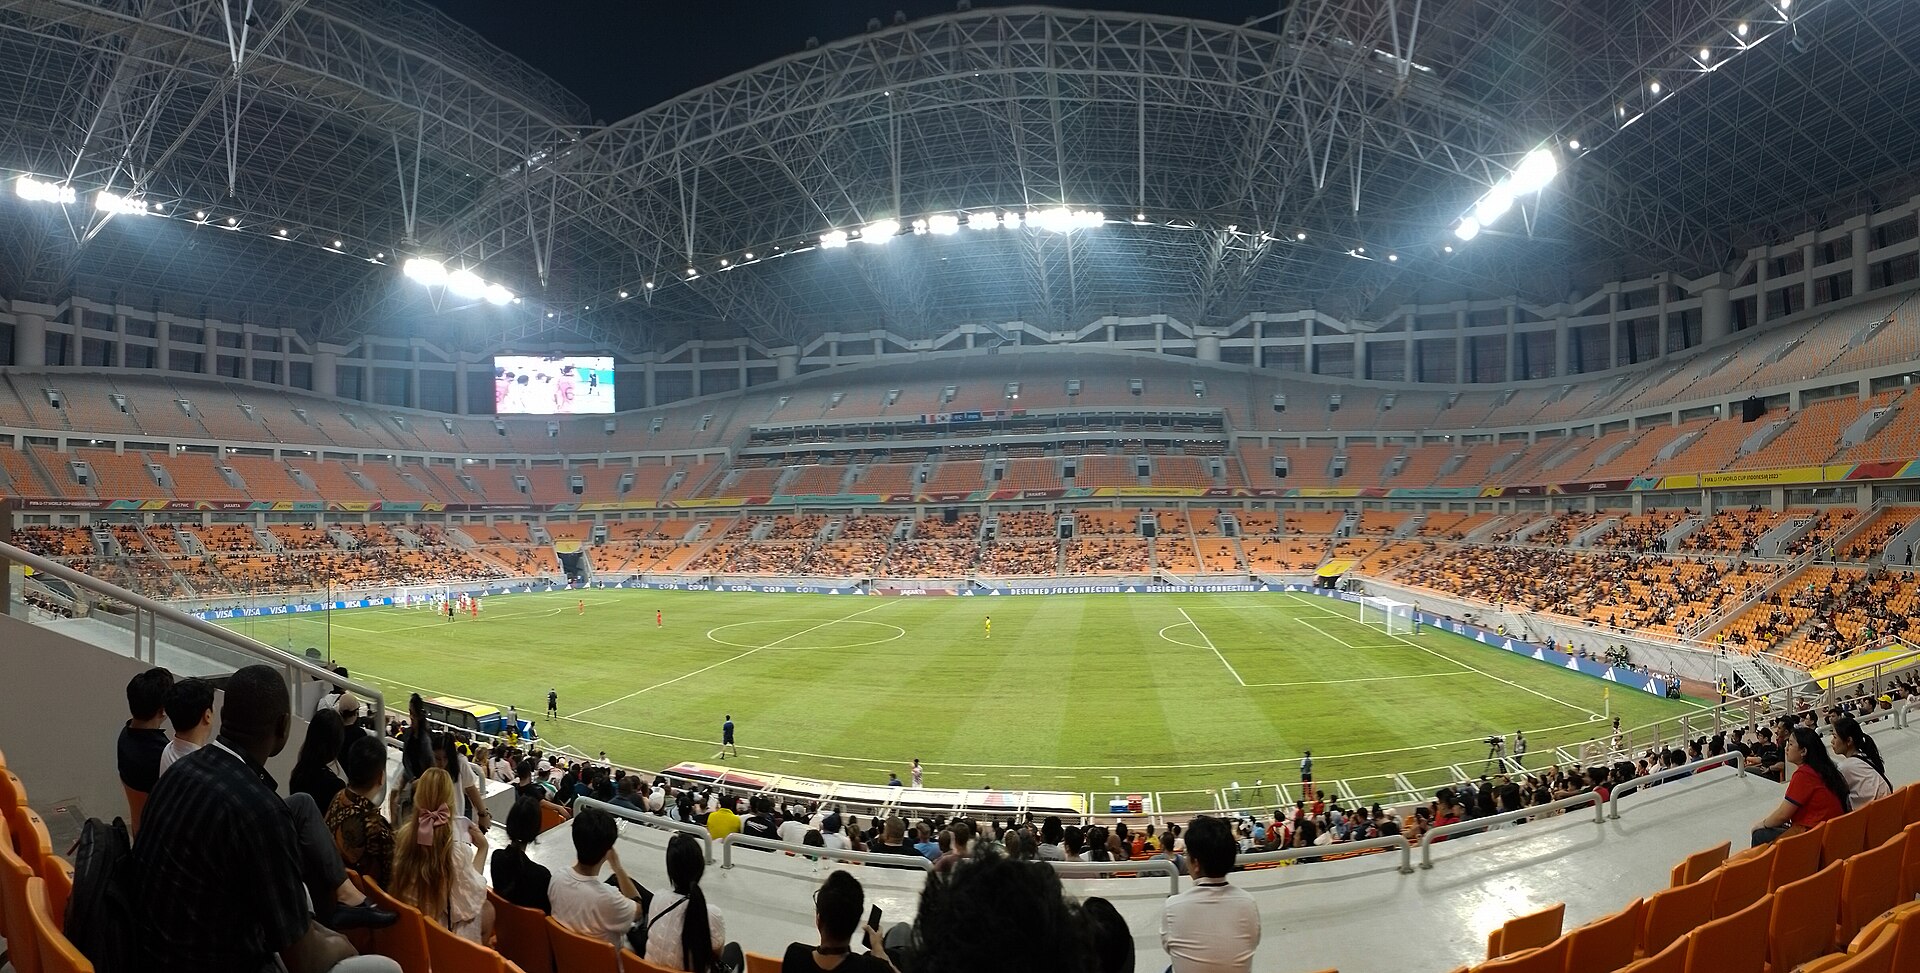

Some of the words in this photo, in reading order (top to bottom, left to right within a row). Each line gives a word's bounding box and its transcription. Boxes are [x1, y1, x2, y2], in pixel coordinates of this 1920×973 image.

[1051, 587, 1068, 595] FOR
[1068, 586, 1120, 594] CONNECTION
[1146, 585, 1186, 593] DESIGNED
[1189, 585, 1204, 593] FOR
[320, 601, 337, 610] VISA
[344, 601, 361, 609] VISA
[369, 598, 384, 606] VISA
[242, 607, 261, 617] VISA
[269, 605, 288, 615] VISA
[294, 604, 312, 613] VISA
[215, 609, 234, 619] VISA
